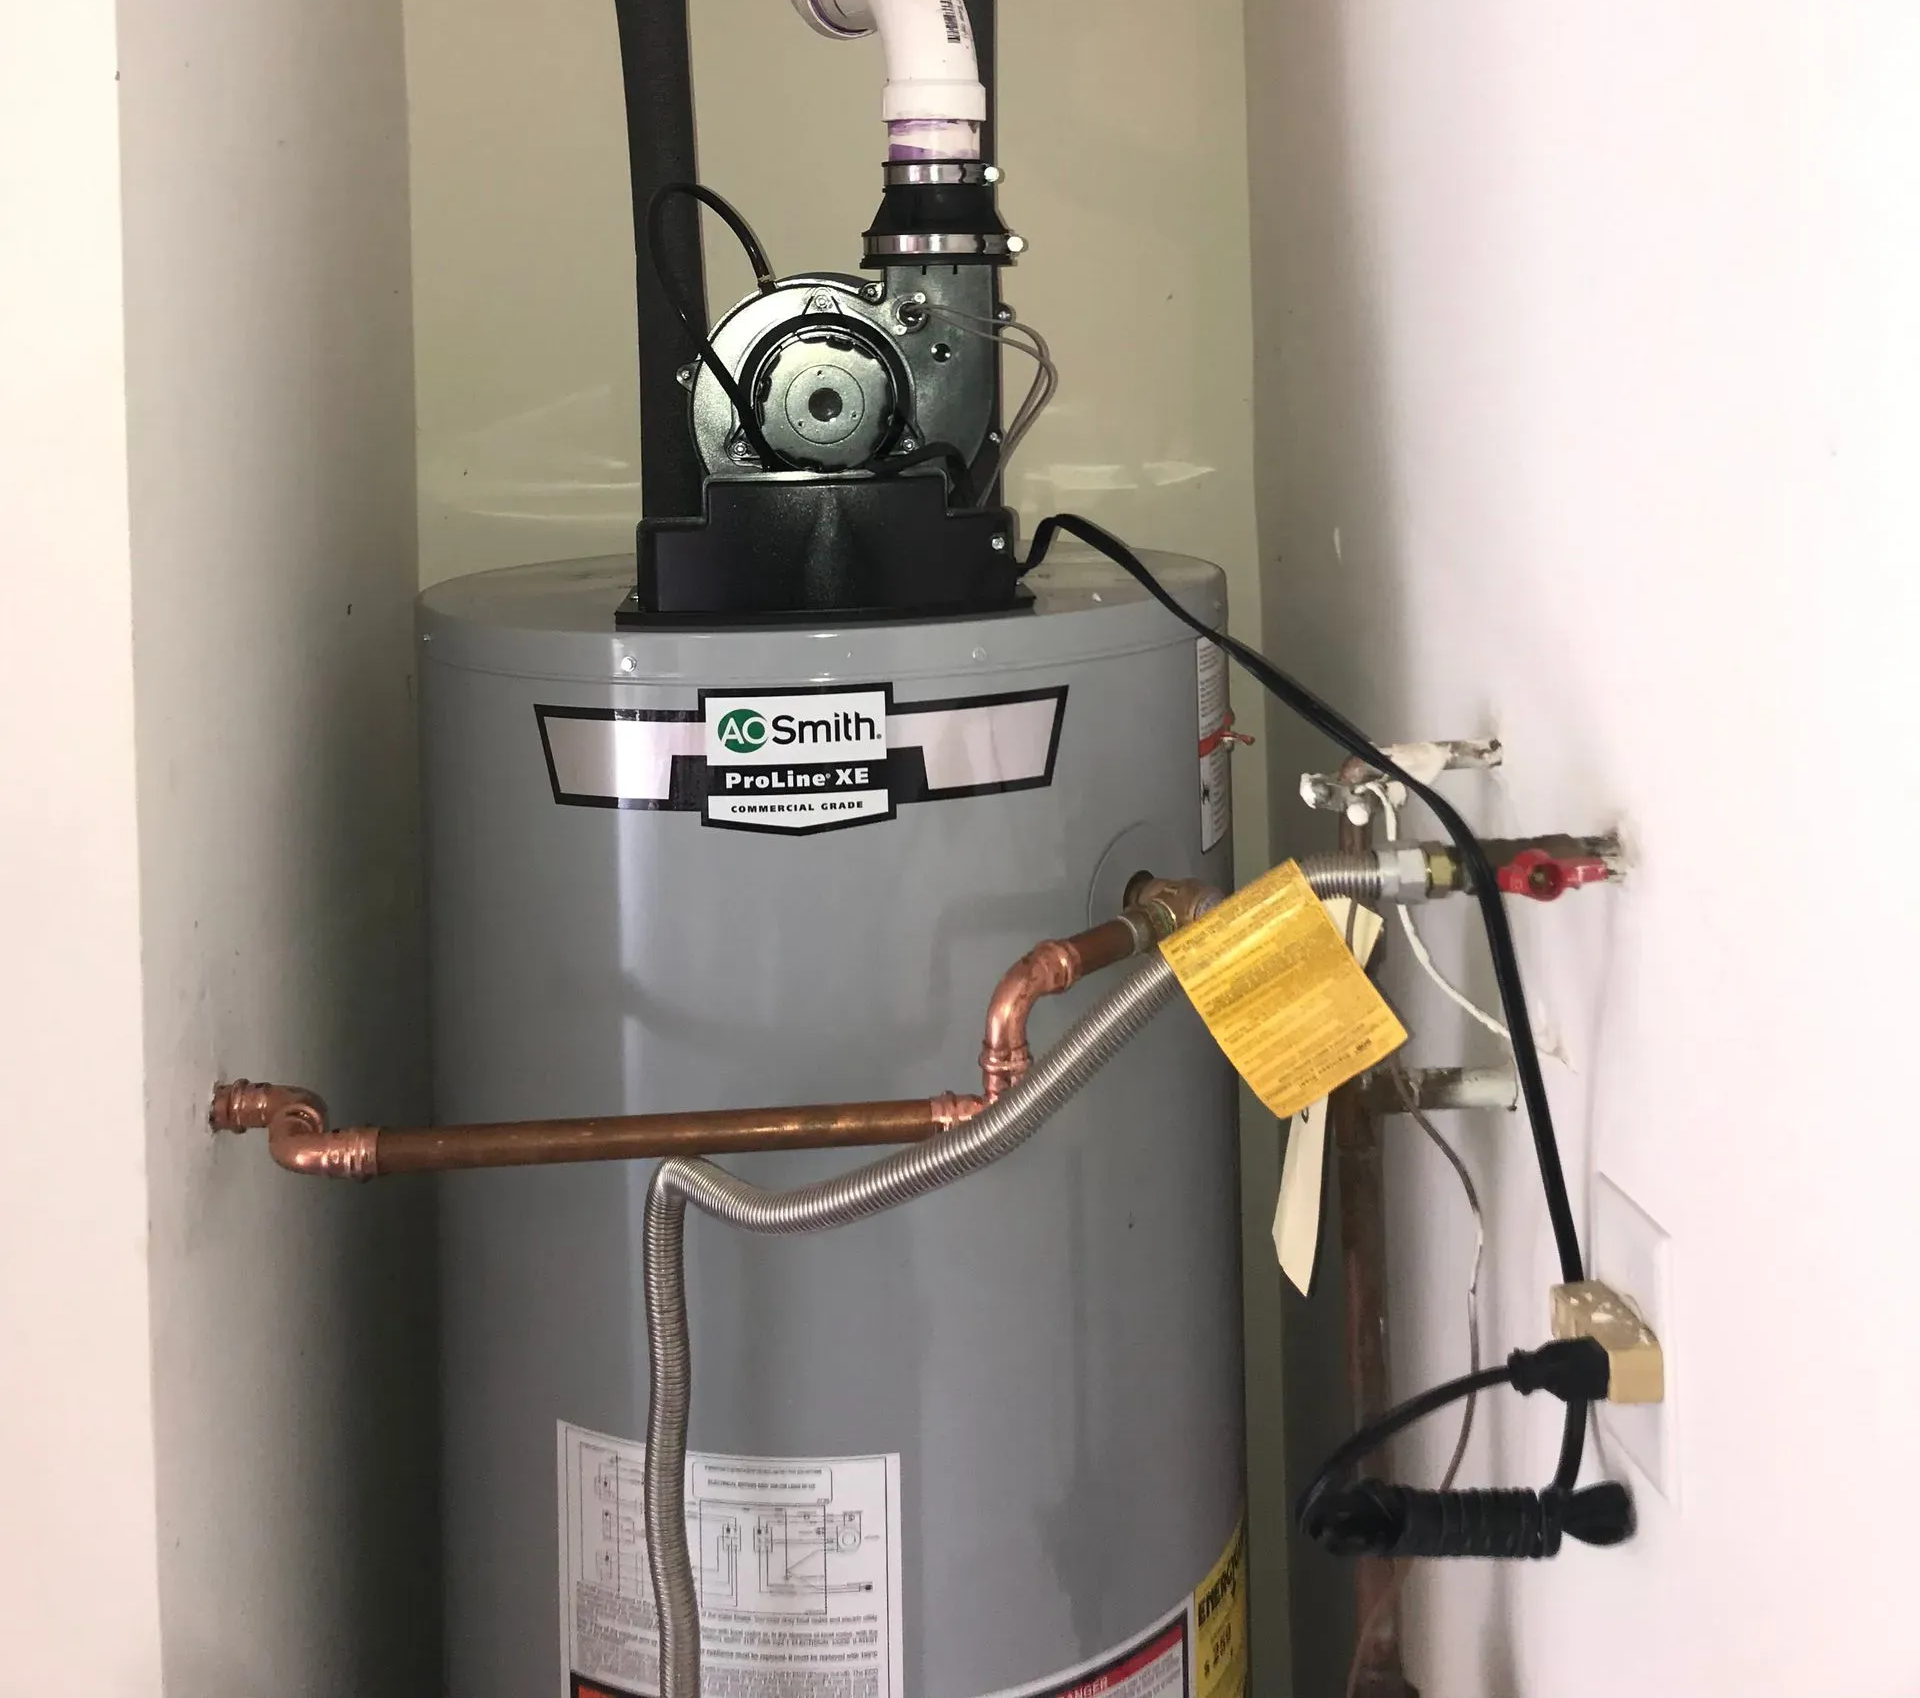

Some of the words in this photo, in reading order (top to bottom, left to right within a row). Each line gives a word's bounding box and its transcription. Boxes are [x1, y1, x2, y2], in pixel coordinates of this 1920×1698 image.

[771, 711, 876, 745] Smith
[835, 767, 869, 786] XE
[731, 803, 815, 814] COMMERCIAL
[821, 800, 863, 811] GRADE
[1056, 1676, 1108, 1698] NGER
